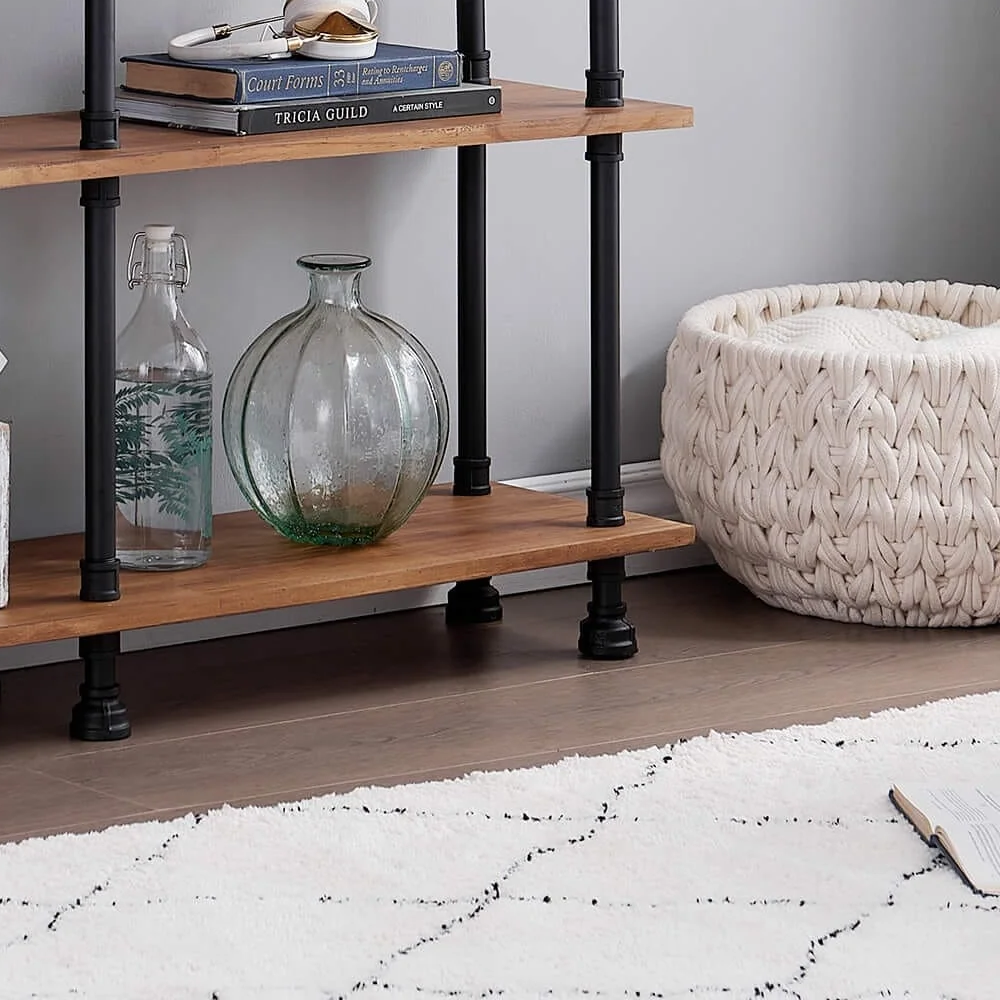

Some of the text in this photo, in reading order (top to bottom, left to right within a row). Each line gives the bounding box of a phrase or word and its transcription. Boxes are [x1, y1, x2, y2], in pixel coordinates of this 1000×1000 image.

[333, 68, 345, 88] 33
[361, 66, 382, 77] Rating
[383, 66, 391, 75] to
[392, 63, 429, 75] Rentcharges
[247, 74, 324, 93] Court Forms
[361, 76, 373, 86] and
[274, 105, 368, 125] TRICIA GUILD
[392, 101, 444, 113] A CERTAIN STYLE
